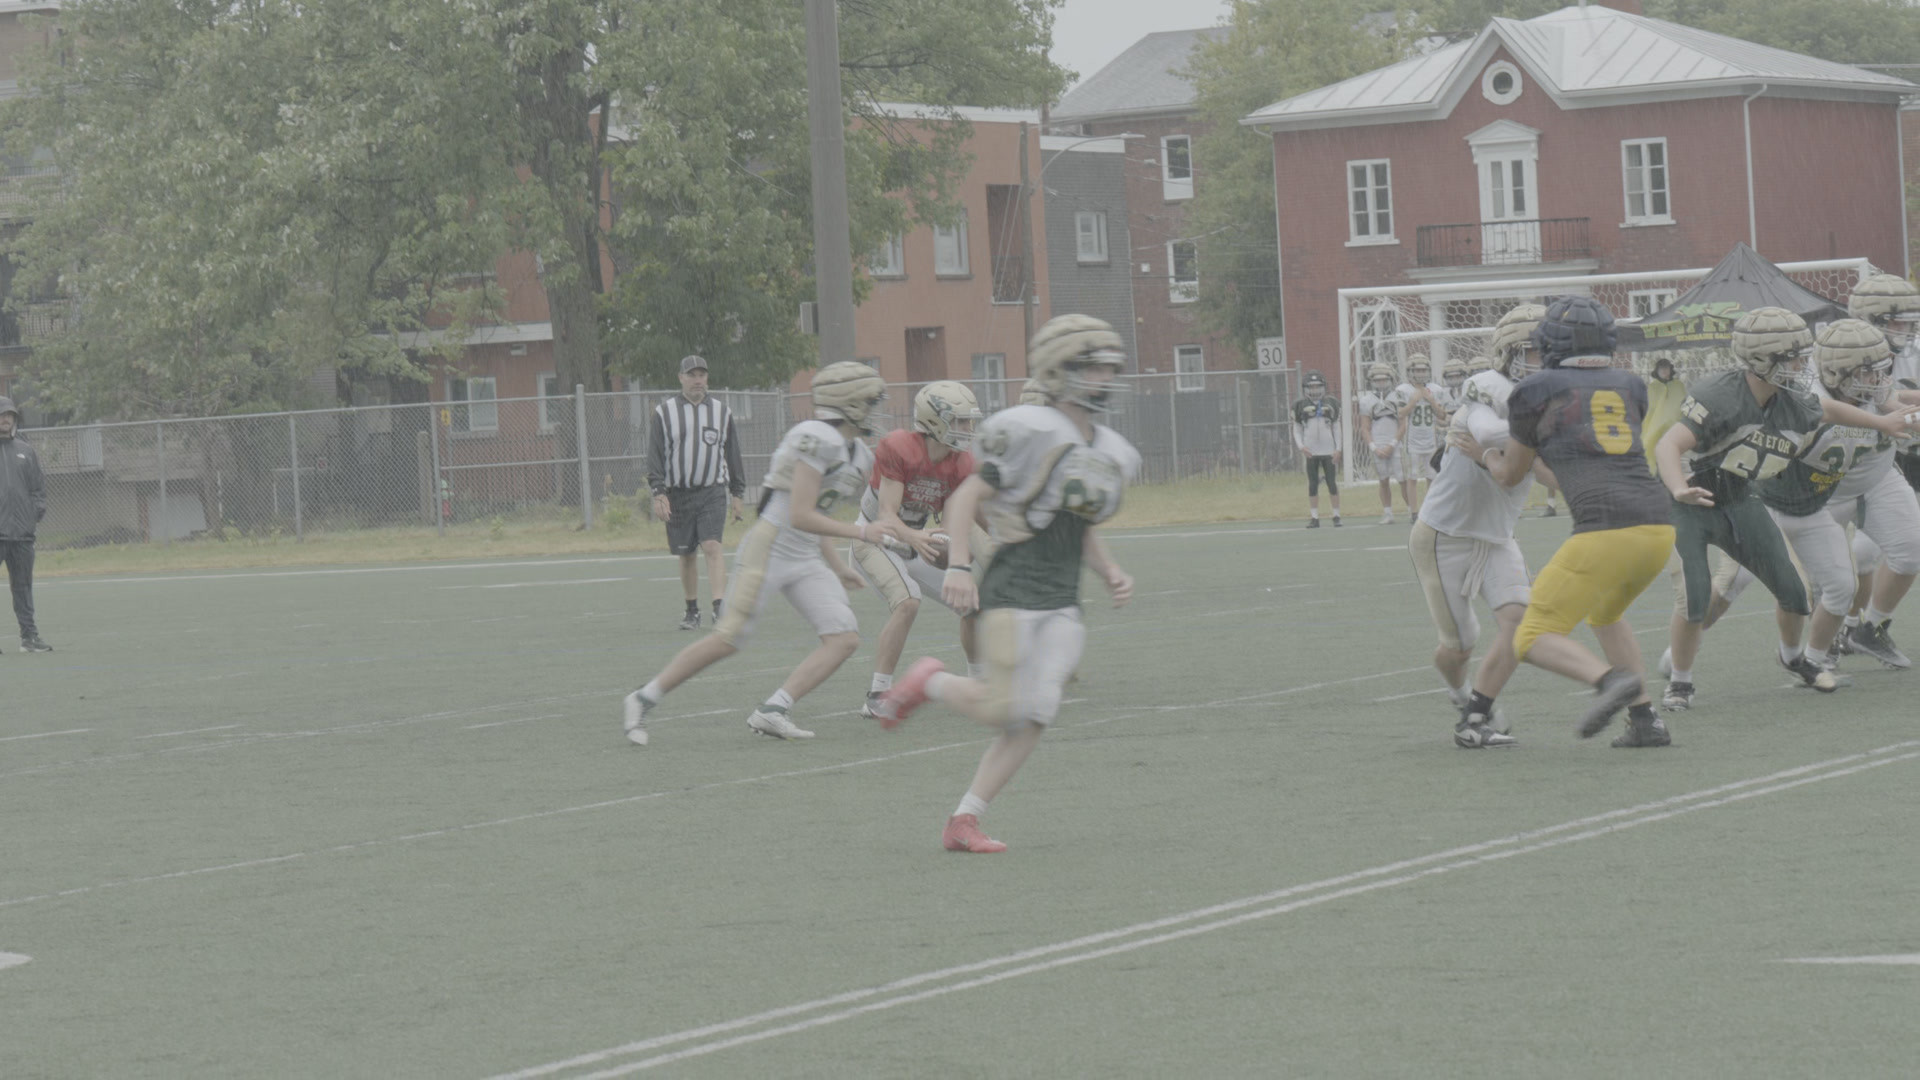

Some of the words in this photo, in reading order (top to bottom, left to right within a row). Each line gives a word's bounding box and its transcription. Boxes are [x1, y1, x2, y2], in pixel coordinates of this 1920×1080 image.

[1261, 347, 1282, 366] 30
[1411, 405, 1434, 426] 88
[1590, 390, 1633, 454] 8
